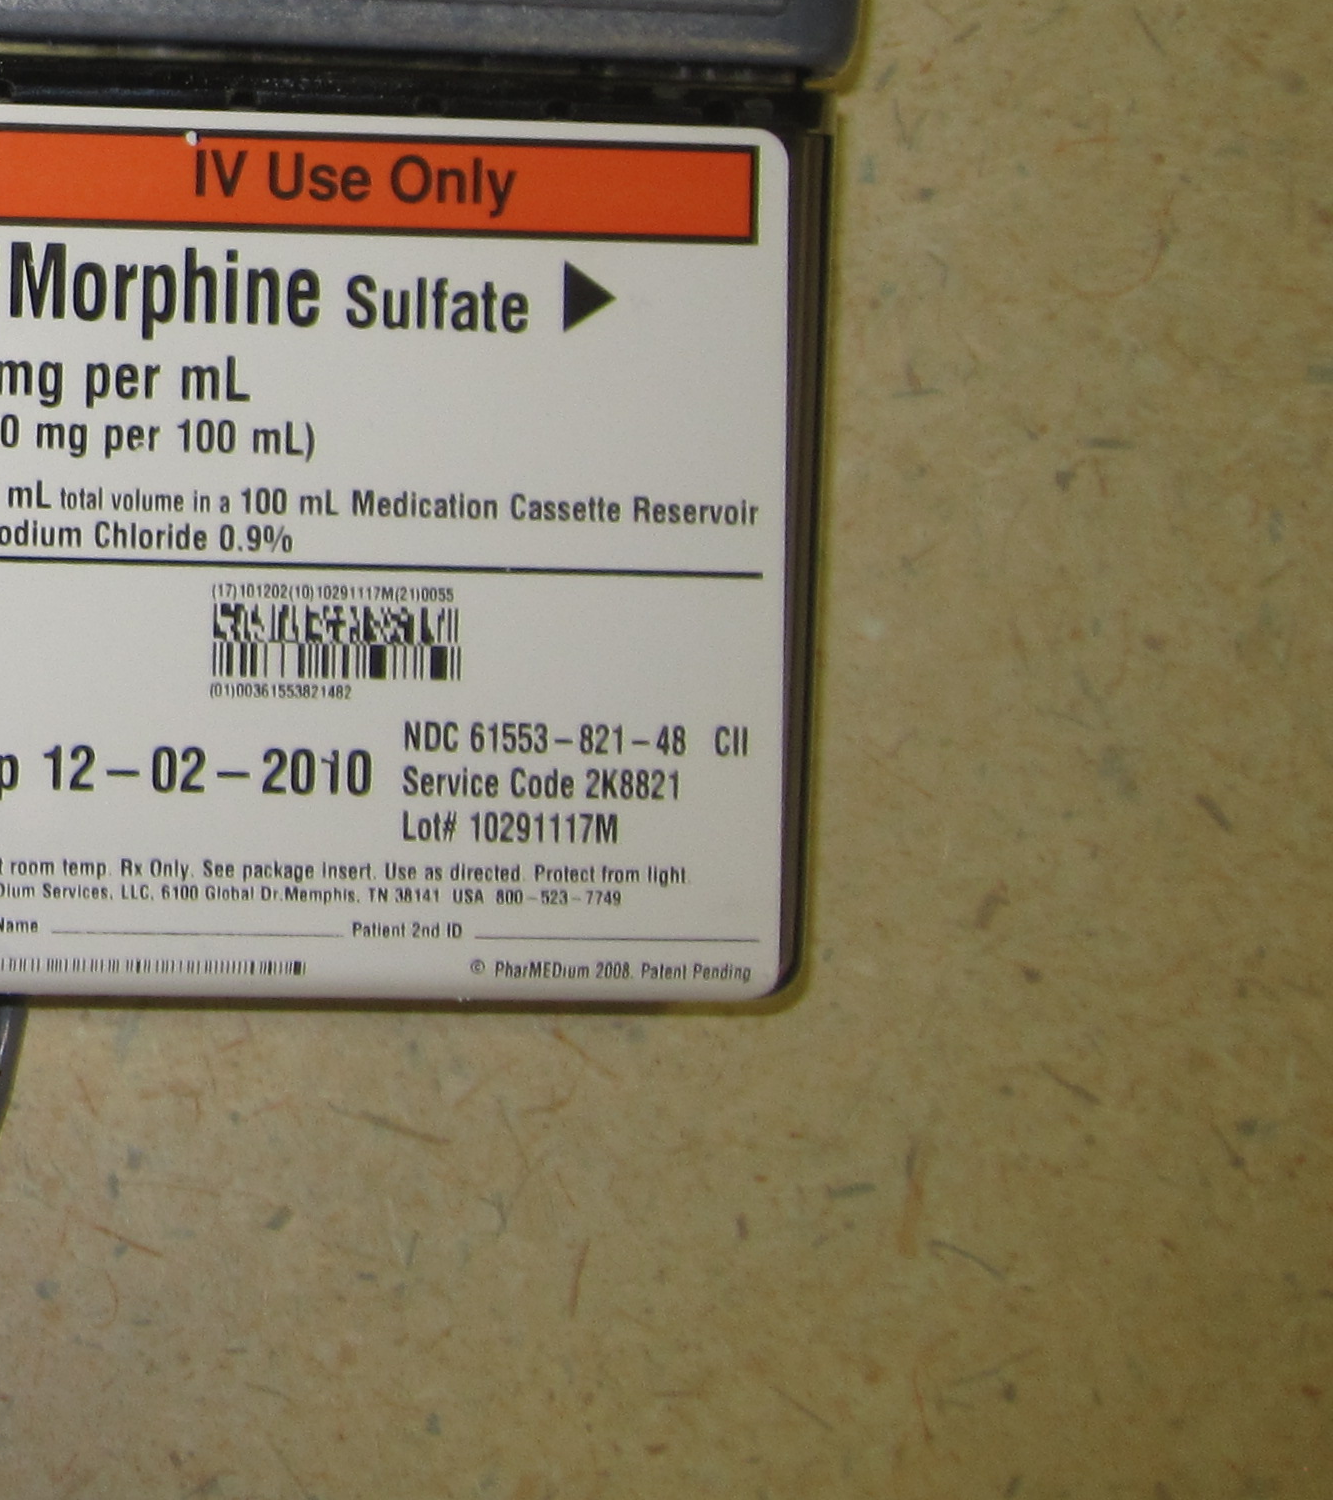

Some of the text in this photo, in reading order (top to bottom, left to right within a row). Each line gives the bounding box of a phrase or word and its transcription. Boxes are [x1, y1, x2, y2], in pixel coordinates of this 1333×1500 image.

[194, 151, 517, 218] IV Use Only
[9, 241, 530, 340] Morphine Sulfate
[86, 361, 161, 409] per
[181, 356, 251, 403] mL
[36, 421, 88, 458] mg
[105, 424, 160, 459] per
[177, 419, 236, 453] 100
[252, 421, 315, 463] mL)
[8, 481, 52, 509] mL
[60, 486, 103, 510] total
[111, 489, 184, 512] volume
[193, 490, 211, 513] in
[219, 496, 231, 514] a
[241, 488, 288, 515] 100
[300, 489, 340, 516] mL
[351, 490, 499, 520] Medication
[510, 493, 621, 523] Cassette
[633, 496, 759, 526] Reservoir
[94, 520, 208, 551] Chloride
[219, 524, 293, 553] 0.9%
[403, 721, 459, 752] NDC
[402, 765, 680, 801] Service Code 2K8821
[402, 810, 619, 844] Lot# 10291117M
[10, 860, 55, 875] room
[63, 859, 112, 880] temp.
[121, 859, 142, 876] Rx
[150, 859, 194, 881] Only.
[203, 859, 235, 878] See
[242, 861, 314, 882] package
[323, 861, 376, 880] insert.
[385, 863, 416, 880] Use
[425, 864, 443, 880] as
[450, 864, 525, 882] directed.
[534, 865, 595, 883] Protect
[601, 866, 640, 883] from
[161, 886, 198, 901] 6100
[205, 886, 254, 901] Global
[369, 887, 388, 903] TN
[395, 888, 439, 903] 38141
[452, 889, 483, 904] USA
[352, 922, 462, 938] Patient 2nd ID
[495, 961, 589, 979] PharMEDium
[641, 963, 687, 980] Patent
[693, 964, 751, 984] Pending
